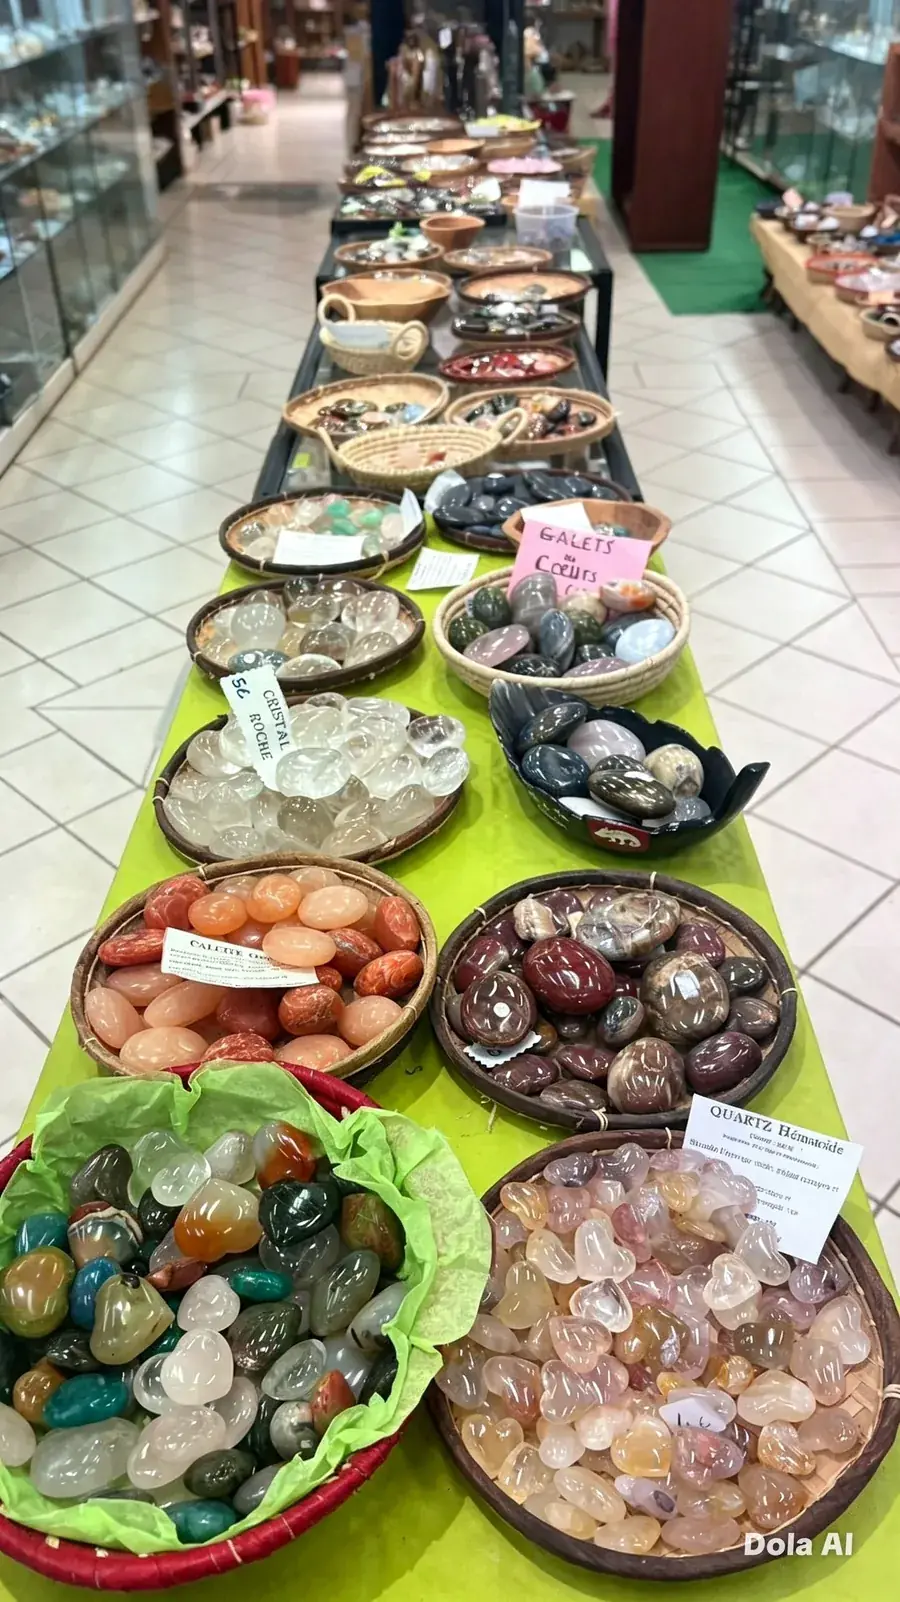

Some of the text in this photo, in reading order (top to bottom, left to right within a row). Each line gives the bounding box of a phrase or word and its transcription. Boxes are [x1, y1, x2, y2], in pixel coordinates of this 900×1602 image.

[540, 526, 615, 554] GALETS
[249, 713, 274, 761] ROCHE
[263, 690, 291, 751] CRISTAL
[710, 1105, 772, 1133] QUARTZ
